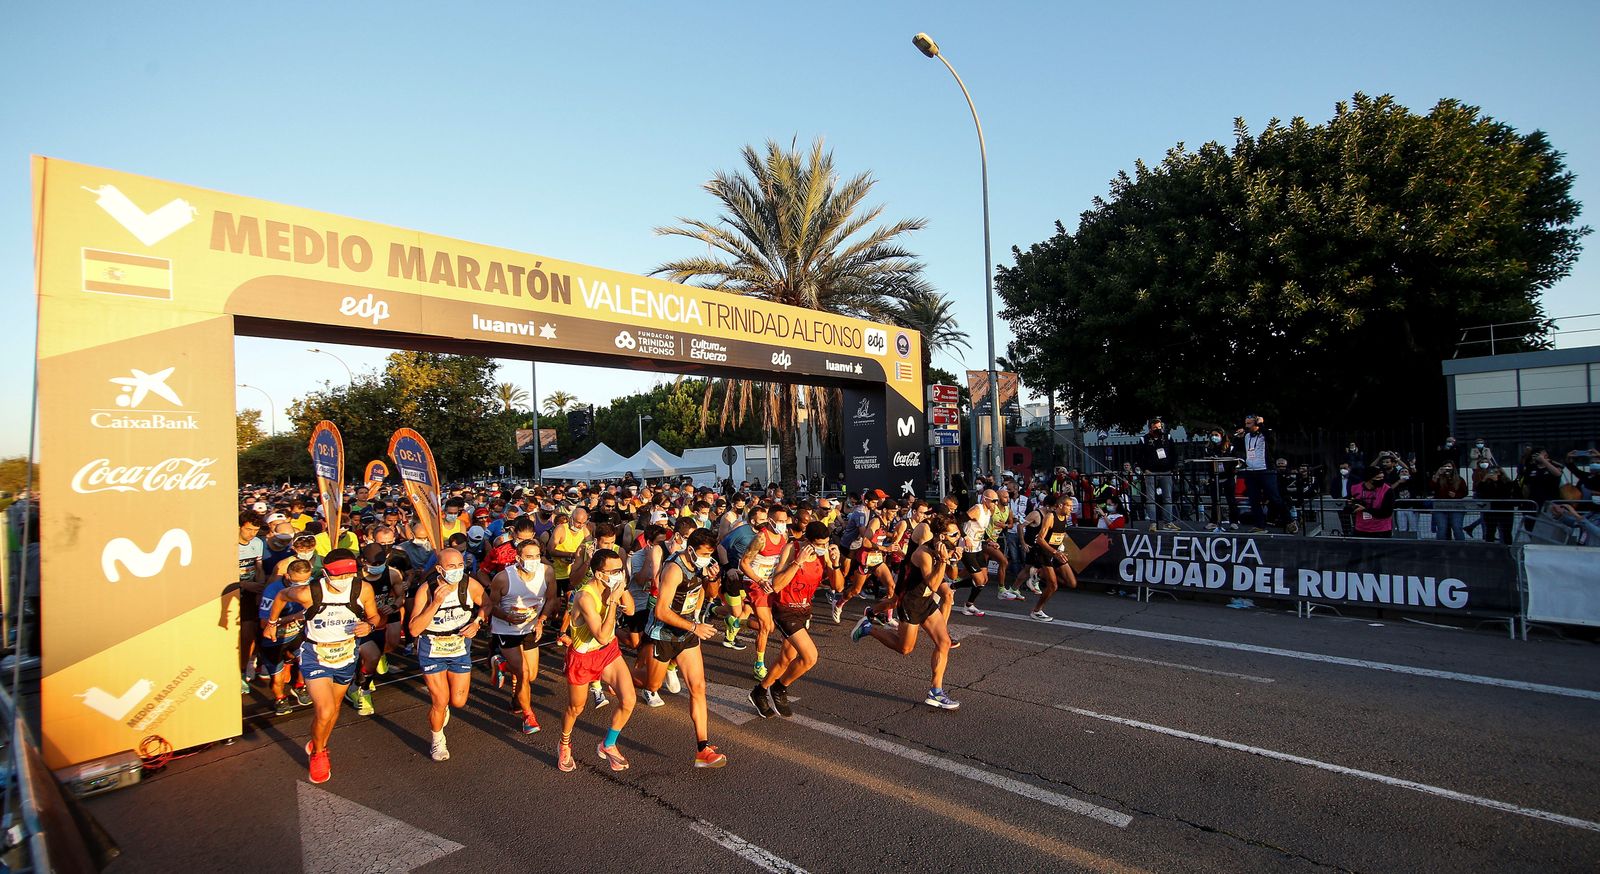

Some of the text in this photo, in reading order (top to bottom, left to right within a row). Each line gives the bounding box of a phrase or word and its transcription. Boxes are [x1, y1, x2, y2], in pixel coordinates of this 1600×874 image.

[210, 211, 862, 350] MEDIO MARATÓN VALENCIA TRINIDAD ALFONSO
[339, 293, 391, 325] edp
[472, 314, 535, 337] luanvi
[638, 331, 675, 340] FUNDACIÓN
[638, 337, 675, 349] TRINIDAD
[690, 338, 720, 351] Cultura
[868, 332, 885, 351] edp
[638, 346, 675, 357] ALFONSO
[690, 348, 728, 362] Esfuerzo
[771, 350, 792, 370] edp
[825, 359, 853, 374] luanvi
[90, 412, 200, 430] CaixaBank
[893, 451, 921, 466] Coca-Cola
[71, 457, 218, 493] Coca-Cola
[1121, 533, 1264, 565] VALENCIA
[1118, 557, 1470, 610] CIUDAD DEL RUNNING
[326, 617, 355, 627] isaval
[126, 702, 155, 729] MEDIO
